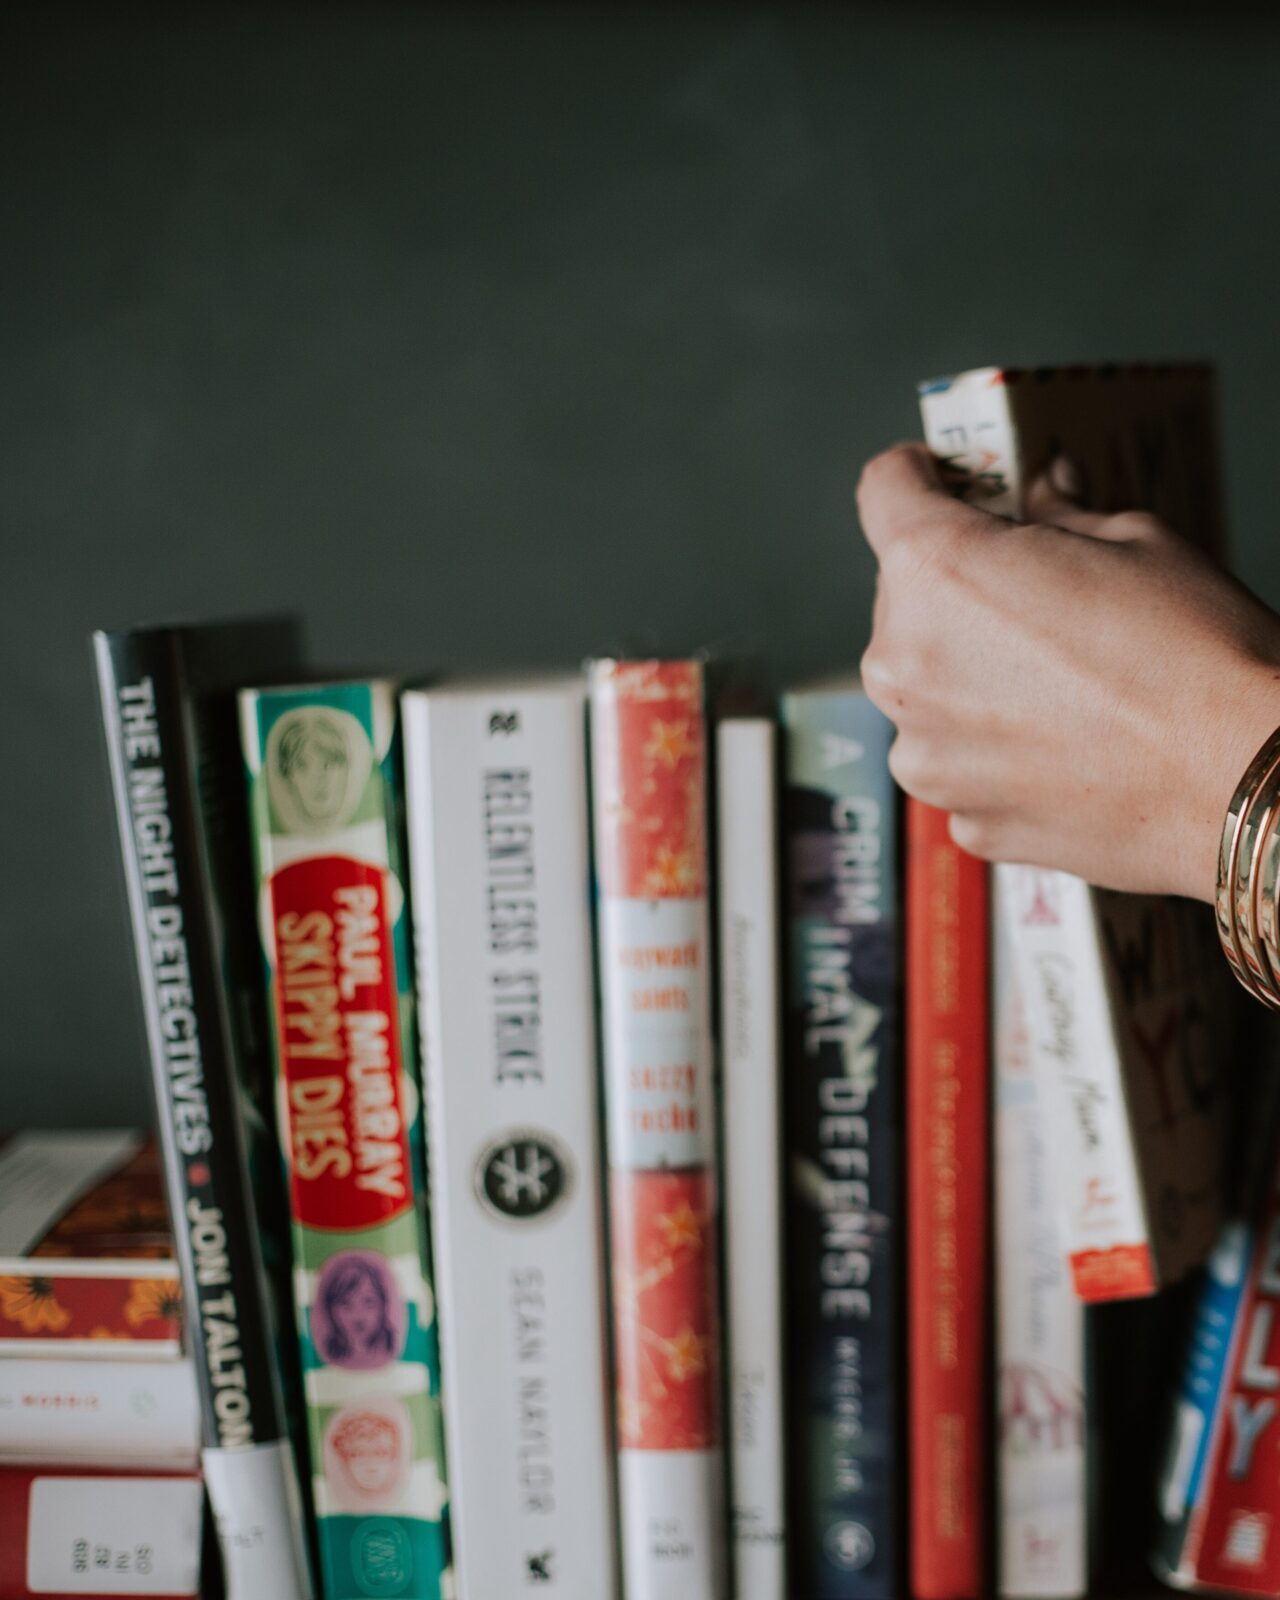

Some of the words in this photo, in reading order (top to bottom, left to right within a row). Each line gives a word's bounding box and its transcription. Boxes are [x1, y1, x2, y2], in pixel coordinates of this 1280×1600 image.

[120, 675, 162, 759] THE
[821, 731, 864, 770] A
[128, 766, 180, 897] NIGHT
[483, 768, 538, 955] RELENTLESS
[278, 910, 346, 1060] SKIPPY
[333, 884, 382, 1001] PAUL
[149, 904, 213, 1155] DETECTIVES
[492, 967, 544, 1087] STRIKE
[291, 1075, 352, 1181] DIES
[343, 1010, 406, 1199] MURRAY
[187, 1196, 232, 1285] JON
[818, 1077, 871, 1320] DEFENSE
[202, 1290, 254, 1447] TALTON
[510, 1266, 546, 1364] SEAN
[517, 1376, 555, 1515] NAYLOR
